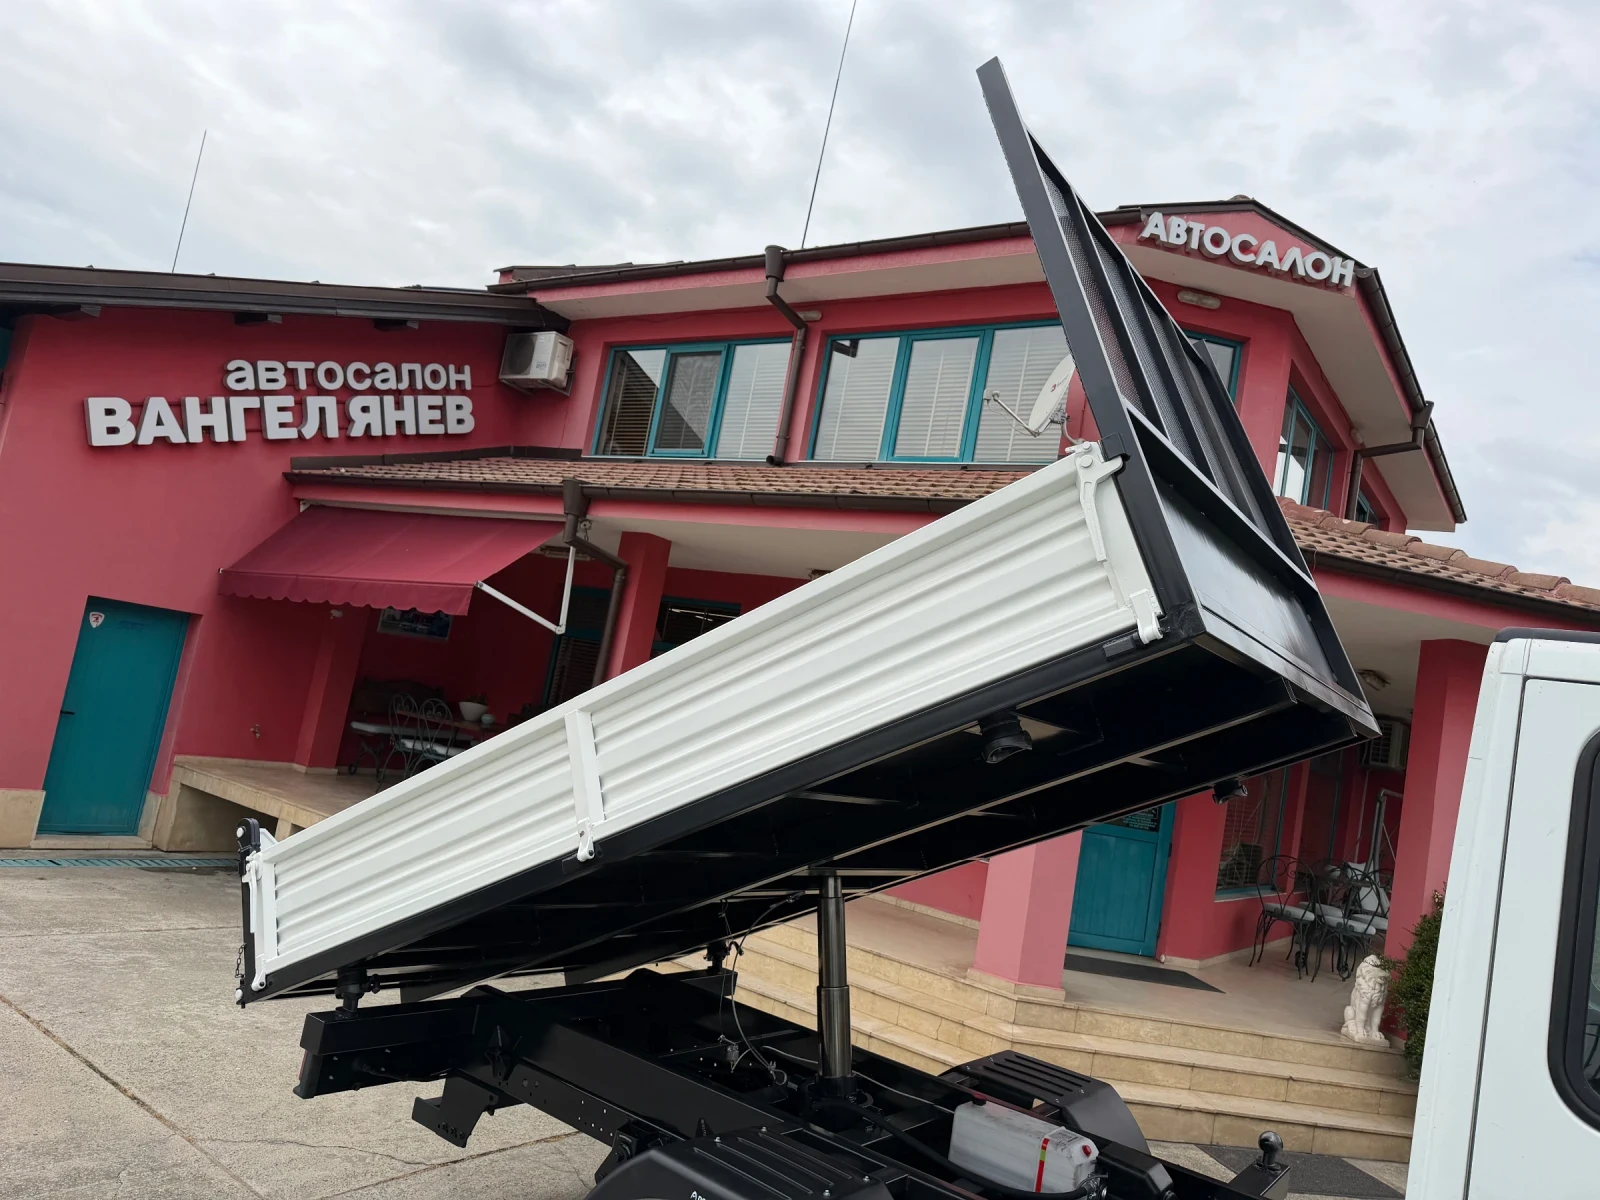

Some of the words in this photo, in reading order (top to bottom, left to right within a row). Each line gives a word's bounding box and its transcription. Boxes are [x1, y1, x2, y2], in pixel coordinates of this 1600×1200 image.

[1139, 211, 1355, 288] АВТОСАЛОН
[225, 358, 472, 391] автосалон
[86, 394, 339, 446] ВАНГЕЛ
[347, 395, 475, 436] ЯНЕВ
